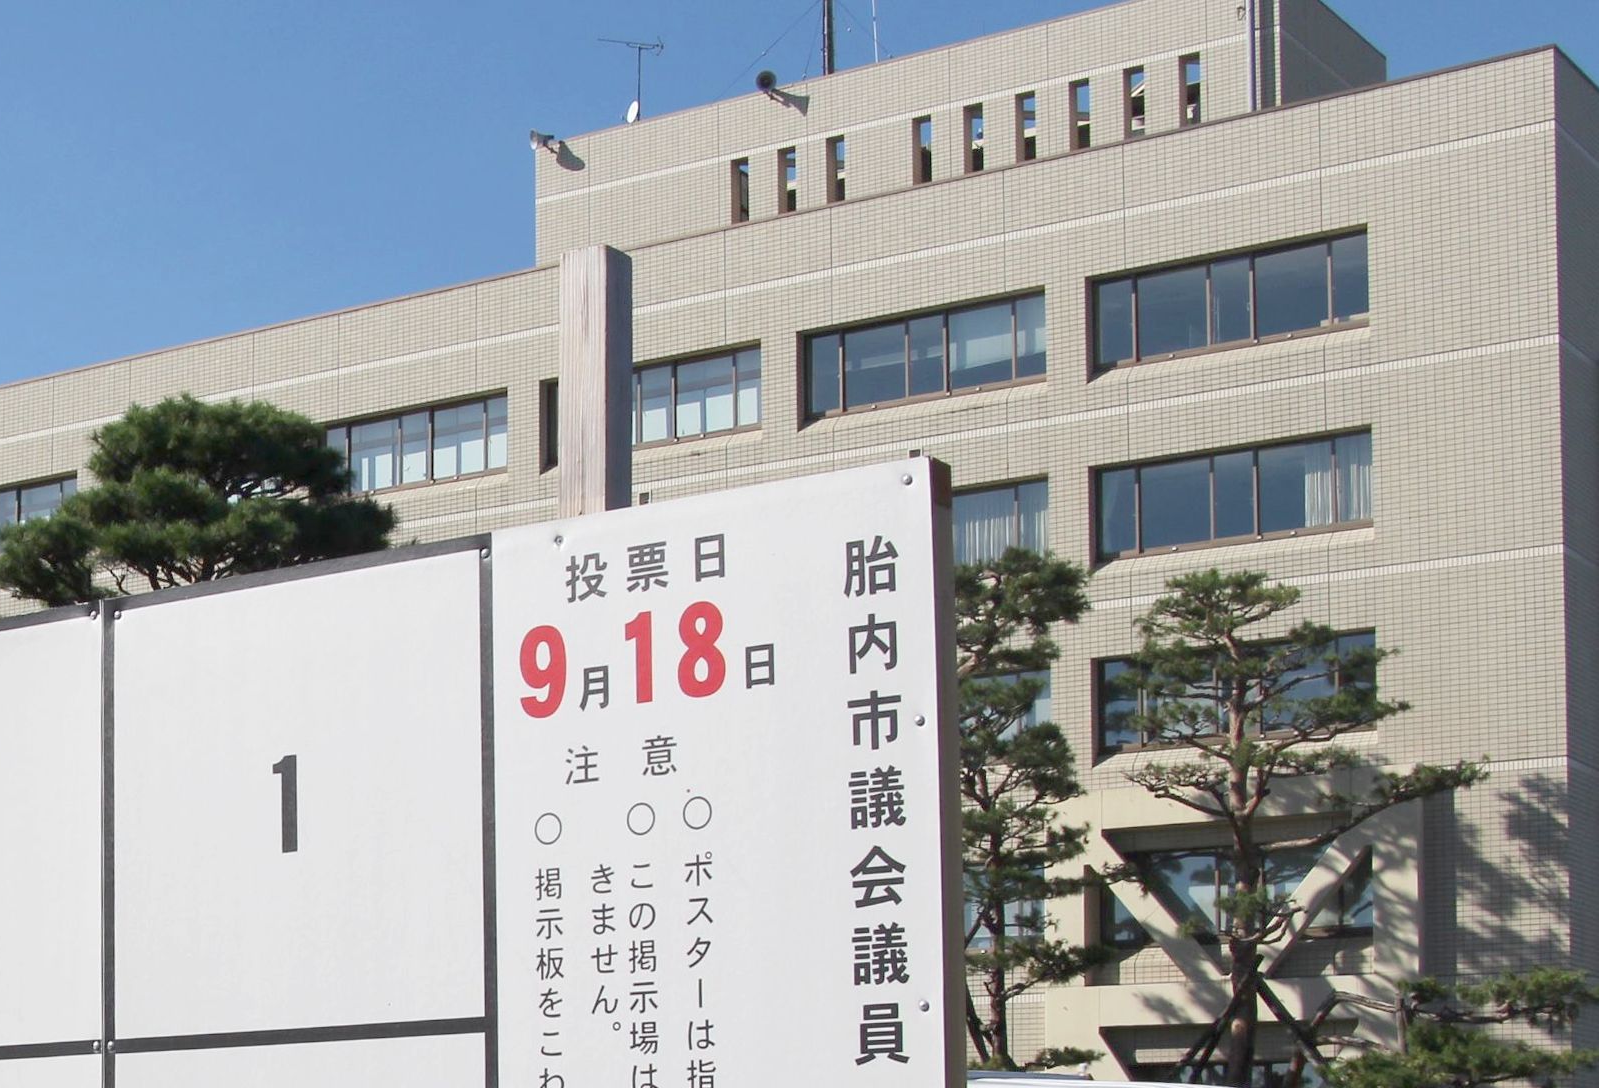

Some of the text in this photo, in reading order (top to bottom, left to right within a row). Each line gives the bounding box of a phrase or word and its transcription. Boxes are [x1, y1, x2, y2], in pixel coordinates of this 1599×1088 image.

[565, 533, 727, 603] 投票日
[519, 600, 776, 719] 9月18日
[272, 754, 298, 854] 1
[564, 734, 678, 786] 注意
[590, 863, 622, 1034] きません。
